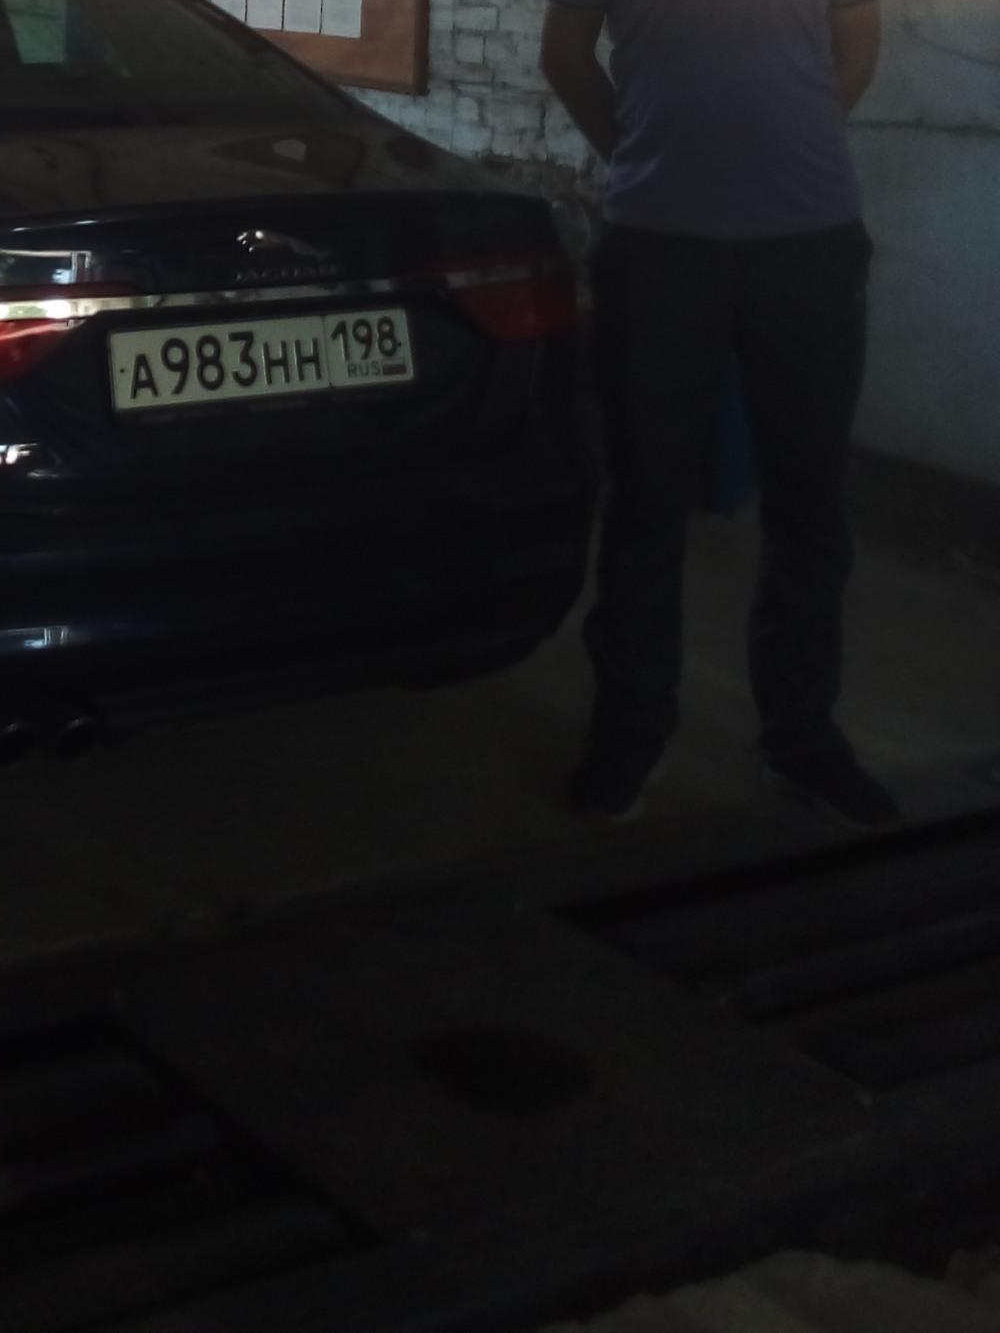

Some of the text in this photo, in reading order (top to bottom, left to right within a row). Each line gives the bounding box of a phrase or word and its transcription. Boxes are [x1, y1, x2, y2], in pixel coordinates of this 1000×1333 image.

[130, 316, 397, 399] A983HH 198
[347, 360, 381, 378] RUS
